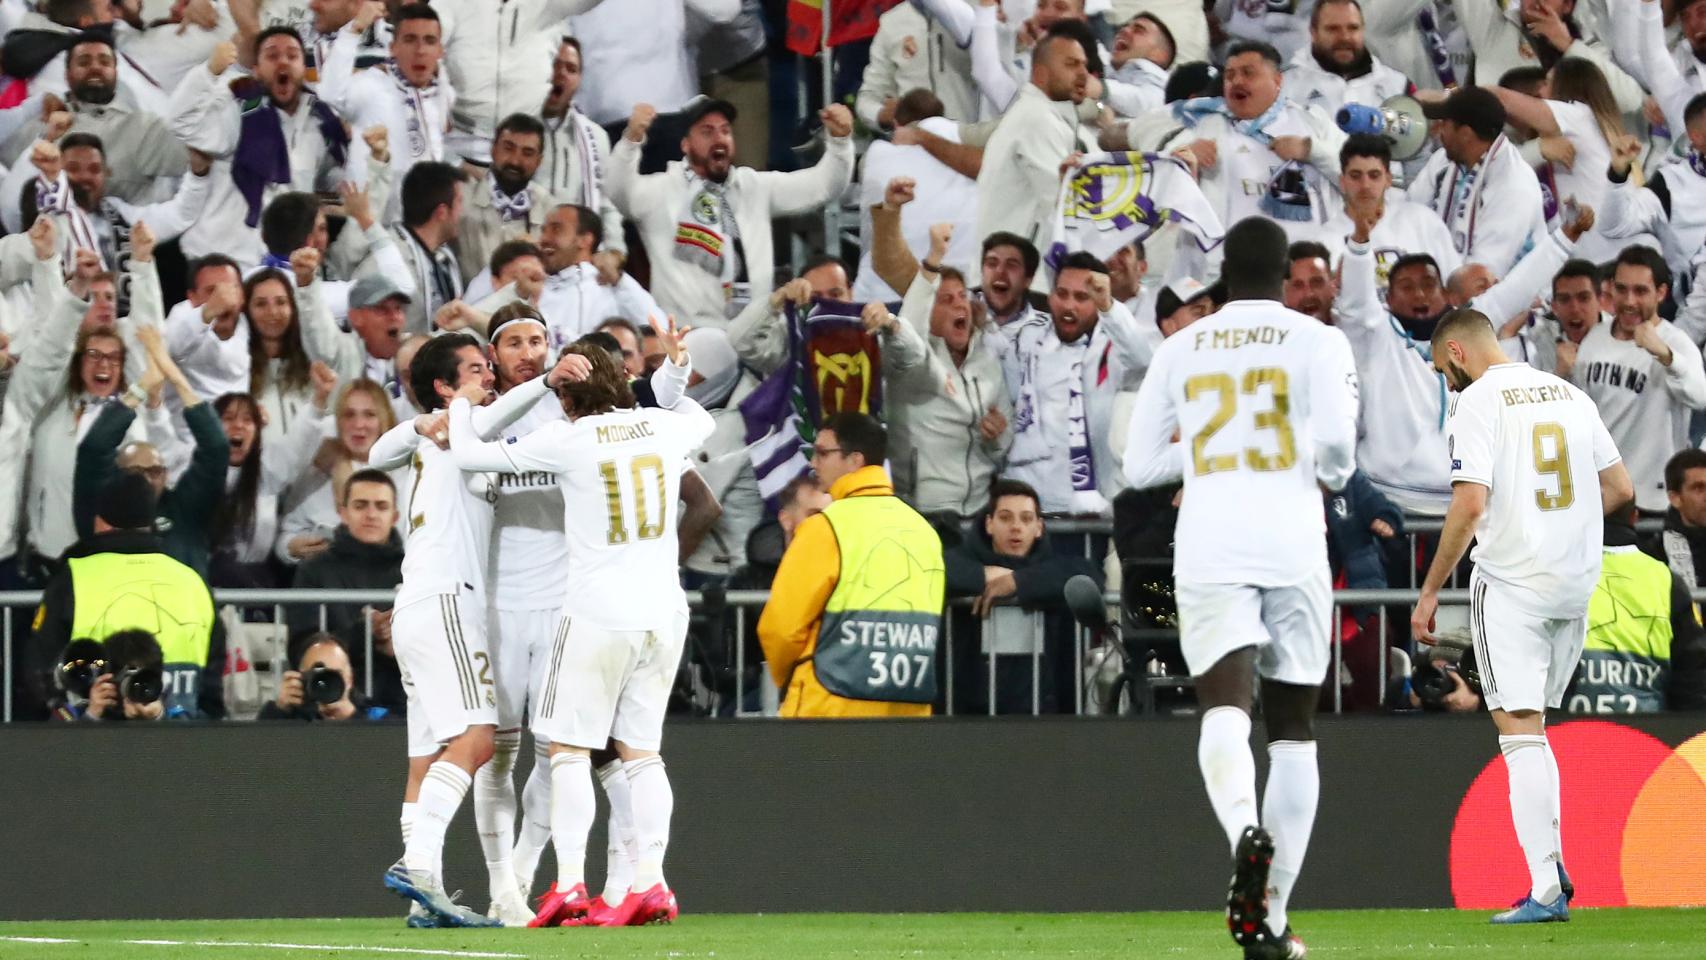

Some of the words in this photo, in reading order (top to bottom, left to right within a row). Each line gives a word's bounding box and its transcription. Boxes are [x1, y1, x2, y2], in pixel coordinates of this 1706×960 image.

[1501, 385, 1574, 407] BENZEMA
[596, 420, 655, 445] MODRIC
[1184, 367, 1297, 476] 23
[1532, 422, 1576, 512] 9
[598, 453, 667, 546] 10
[473, 651, 494, 685] 2
[867, 652, 930, 688] 307
